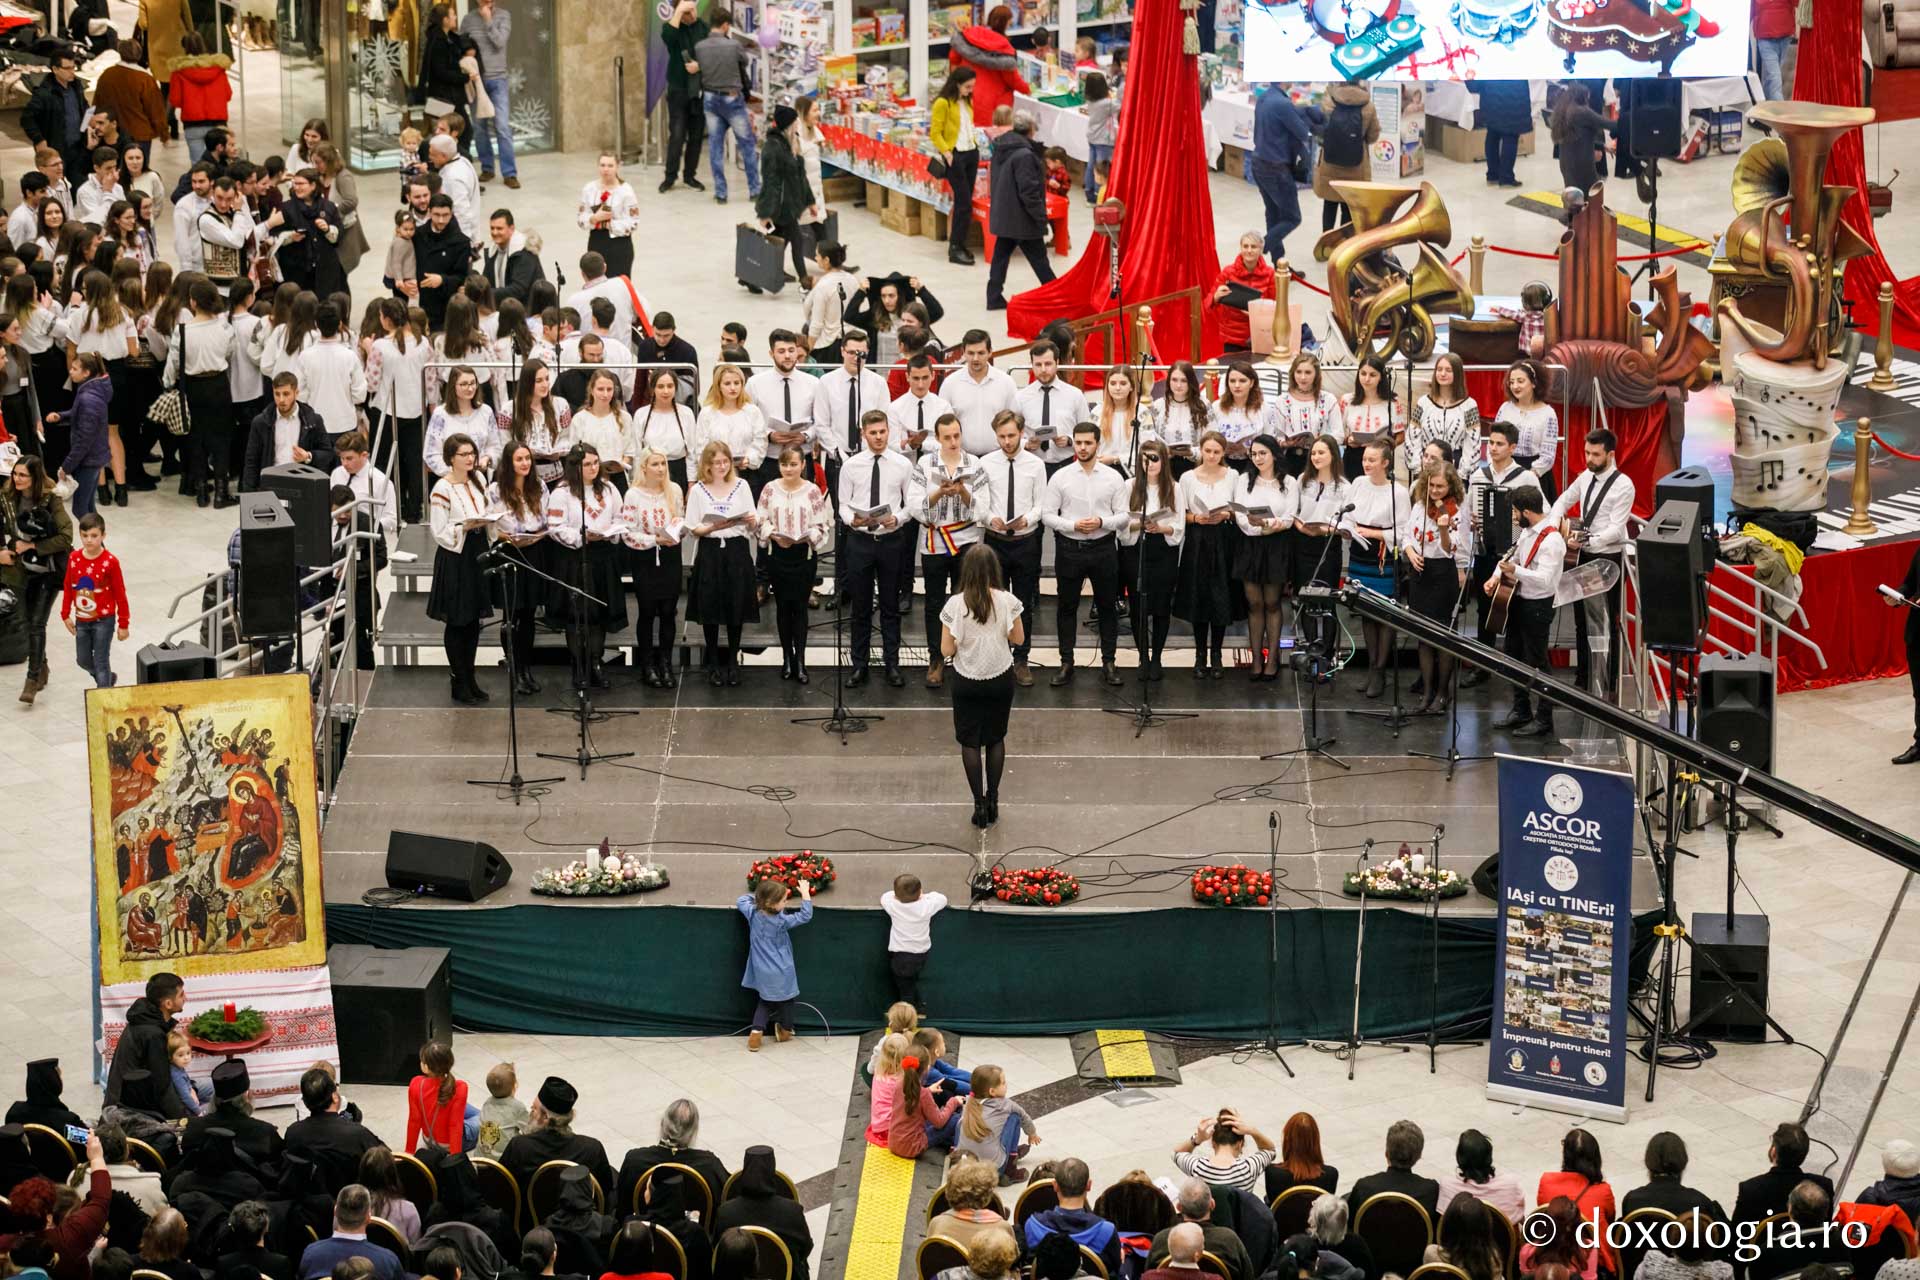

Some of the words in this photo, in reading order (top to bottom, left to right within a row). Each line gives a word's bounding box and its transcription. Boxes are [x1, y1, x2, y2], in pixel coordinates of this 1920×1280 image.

[1522, 811, 1602, 840] ASCOR
[1538, 895, 1556, 907] cu
[1559, 895, 1615, 917] TINEri!
[1502, 1028, 1548, 1047] Împreună
[1549, 1040, 1582, 1053] pentru
[1583, 1045, 1612, 1058] tineri!
